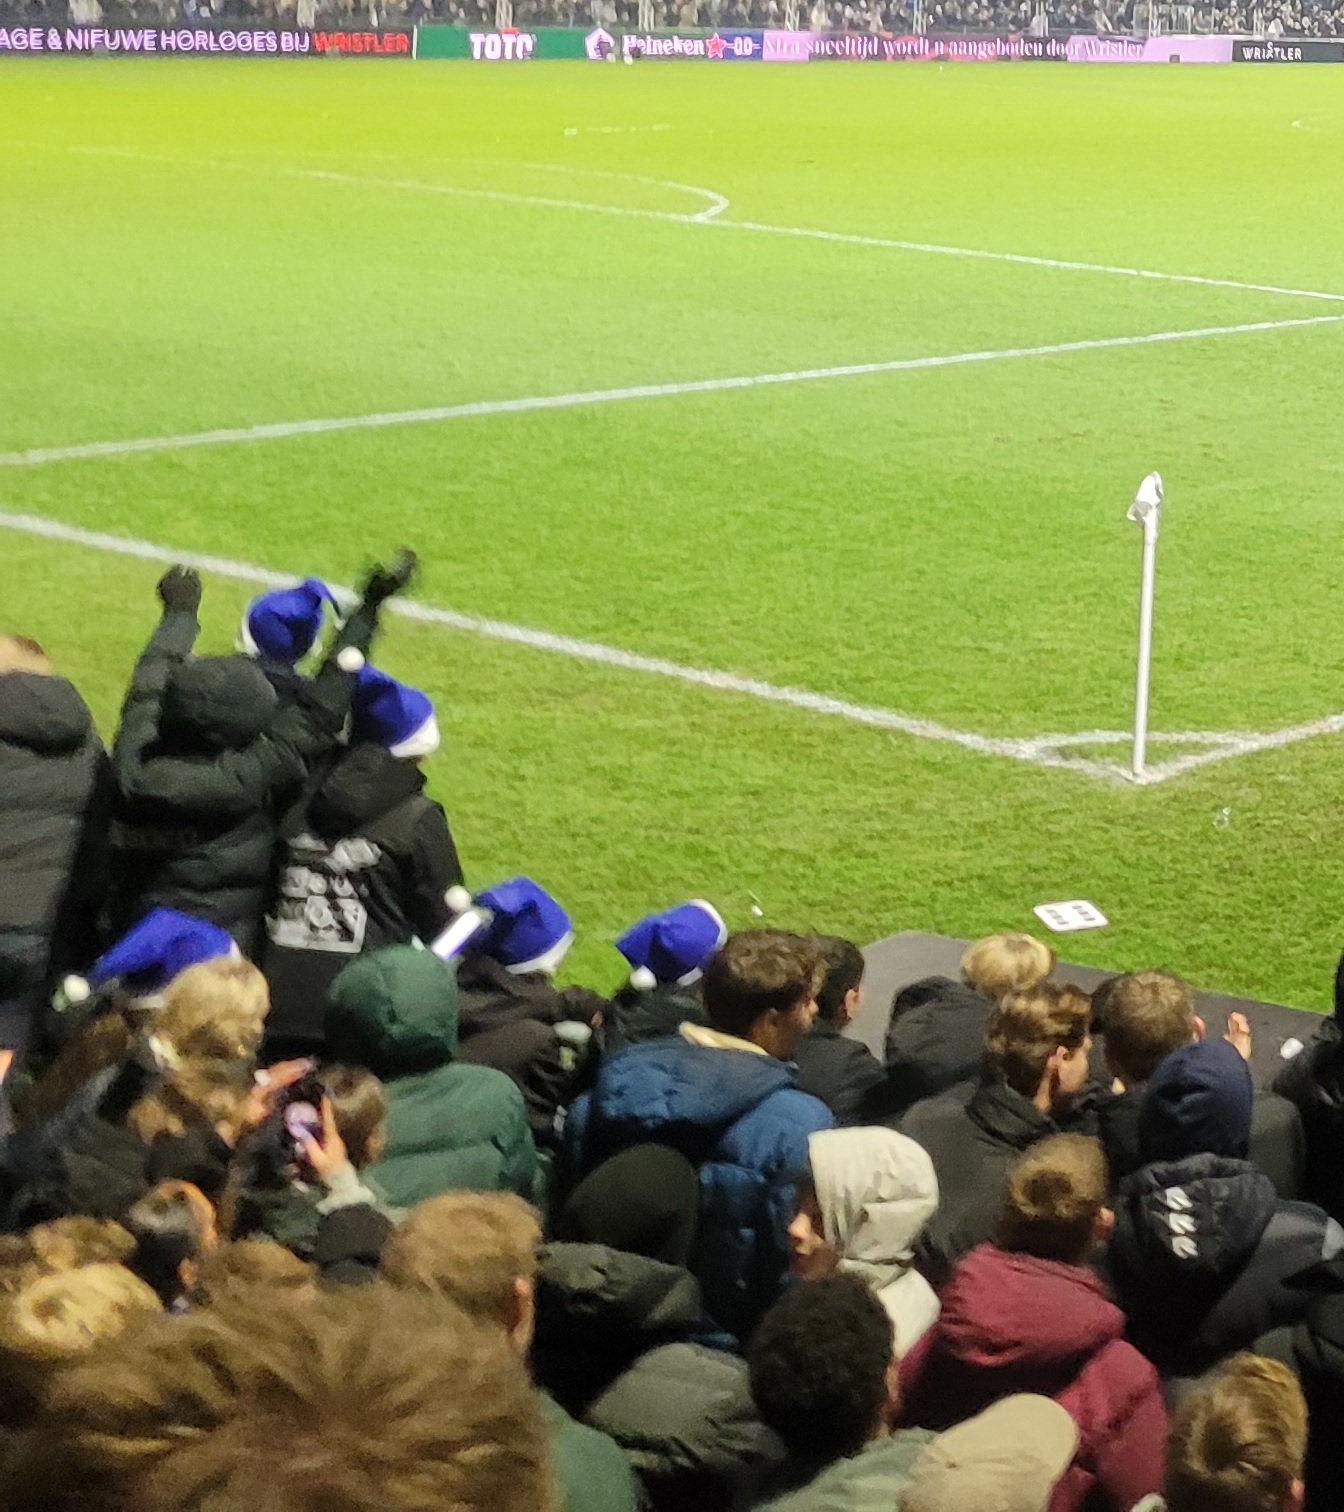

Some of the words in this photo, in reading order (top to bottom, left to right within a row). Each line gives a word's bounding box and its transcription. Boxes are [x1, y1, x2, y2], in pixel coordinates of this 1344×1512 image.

[622, 34, 706, 56] Heineken
[949, 38, 1043, 60] aangeboden
[1046, 38, 1082, 57] door
[1084, 39, 1144, 58] Wristler
